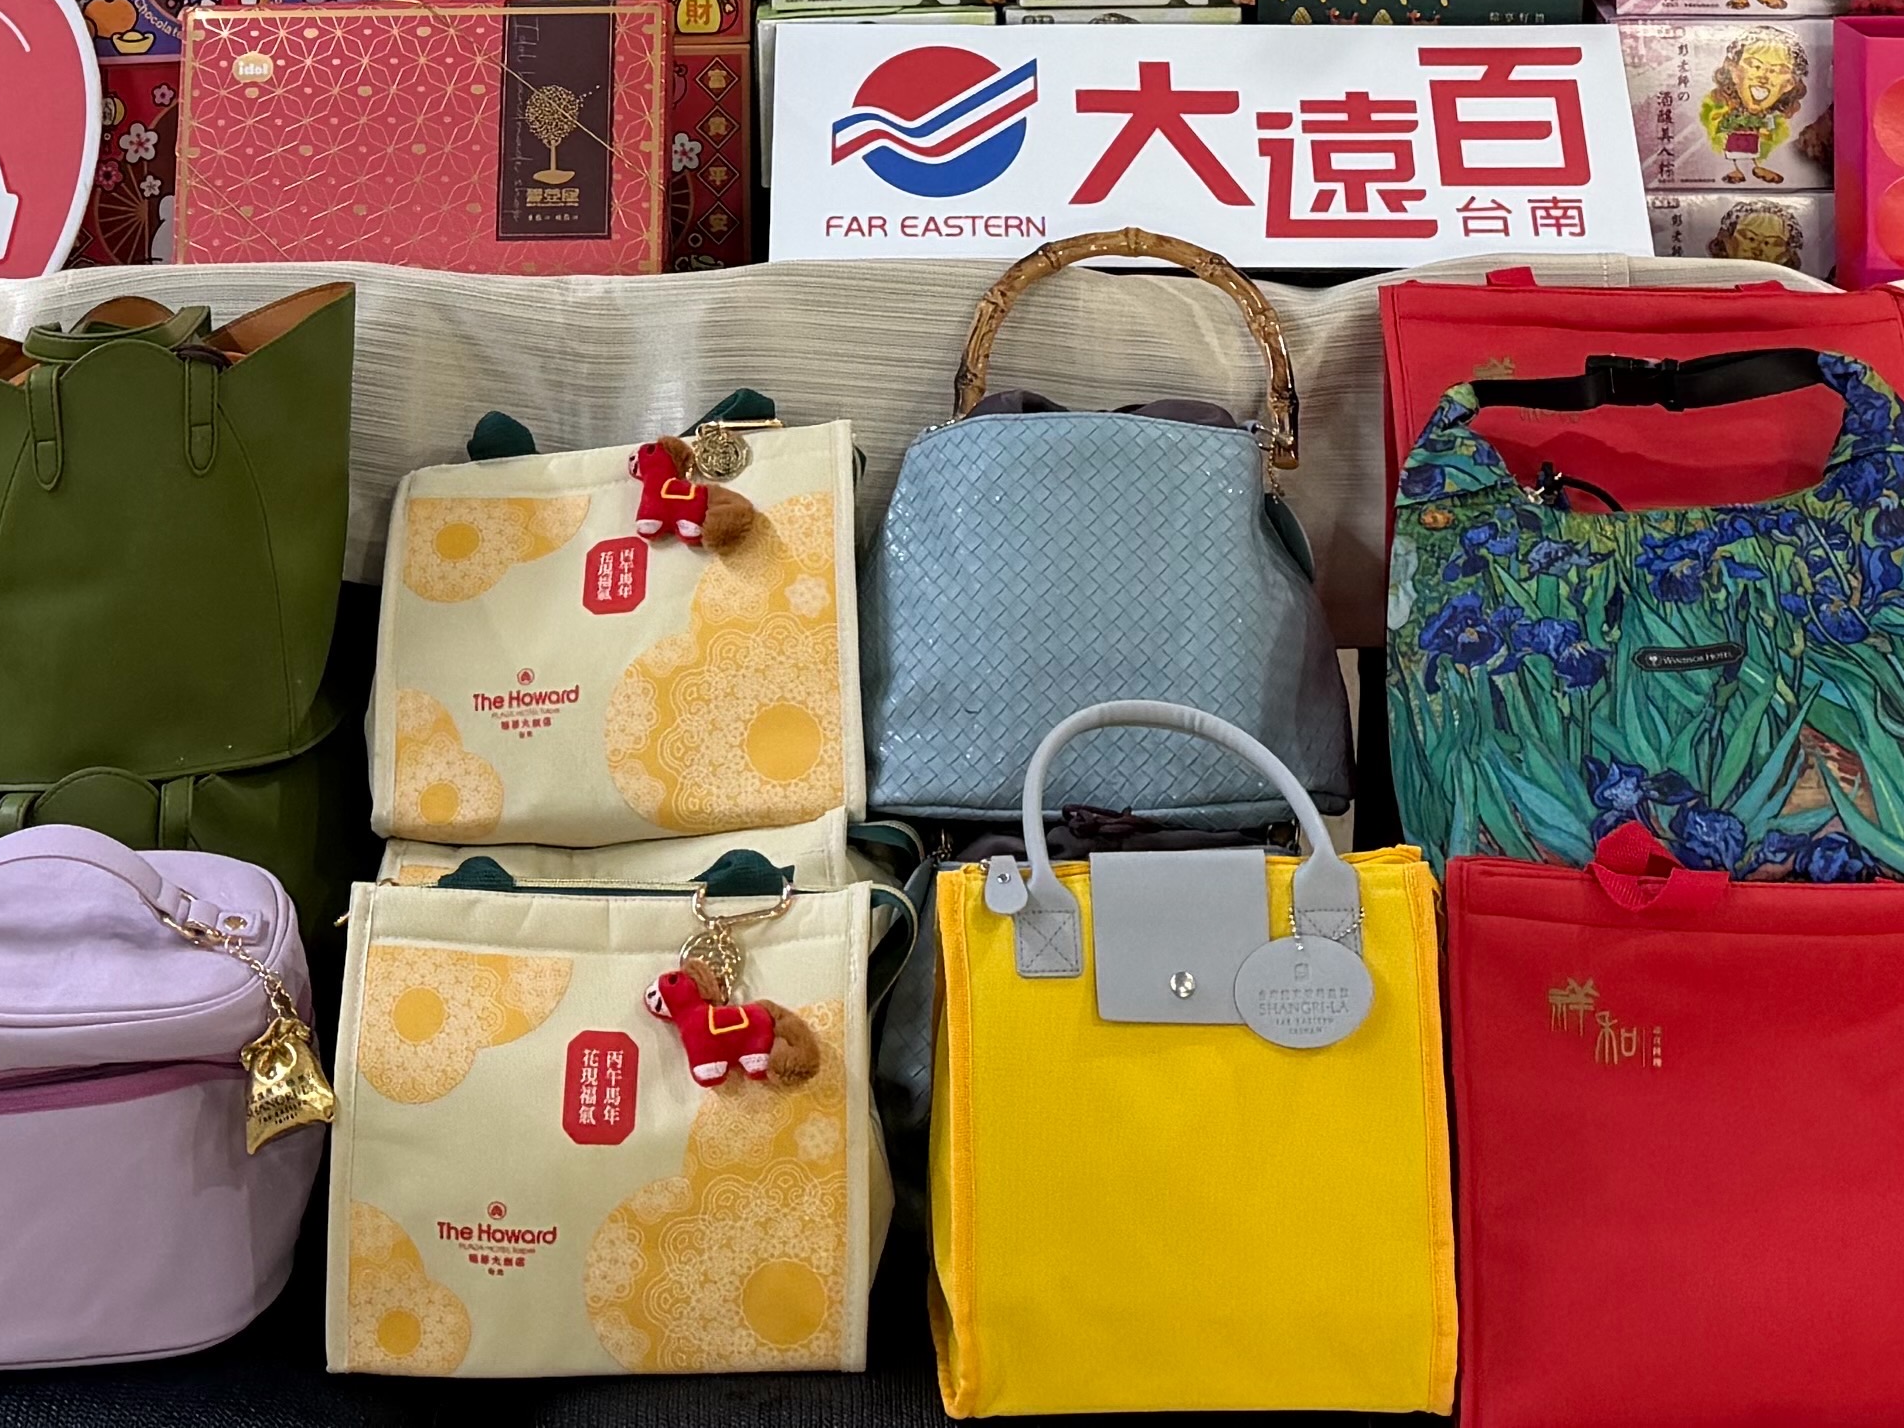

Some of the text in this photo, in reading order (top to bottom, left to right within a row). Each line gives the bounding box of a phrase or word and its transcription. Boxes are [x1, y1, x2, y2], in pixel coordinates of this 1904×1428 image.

[238, 61, 269, 76] idol
[1678, 44, 1690, 101] 彭老師の
[1069, 46, 1592, 239] 大遠百
[825, 214, 1047, 238] FAR EASTERN
[1456, 196, 1586, 238] 台南
[473, 685, 580, 711] The Howard
[1548, 976, 1636, 1065] 祥和
[578, 1047, 601, 1126] 花現福氣
[603, 1048, 625, 1126] 丙午馬年
[437, 1221, 558, 1245] The Howard
